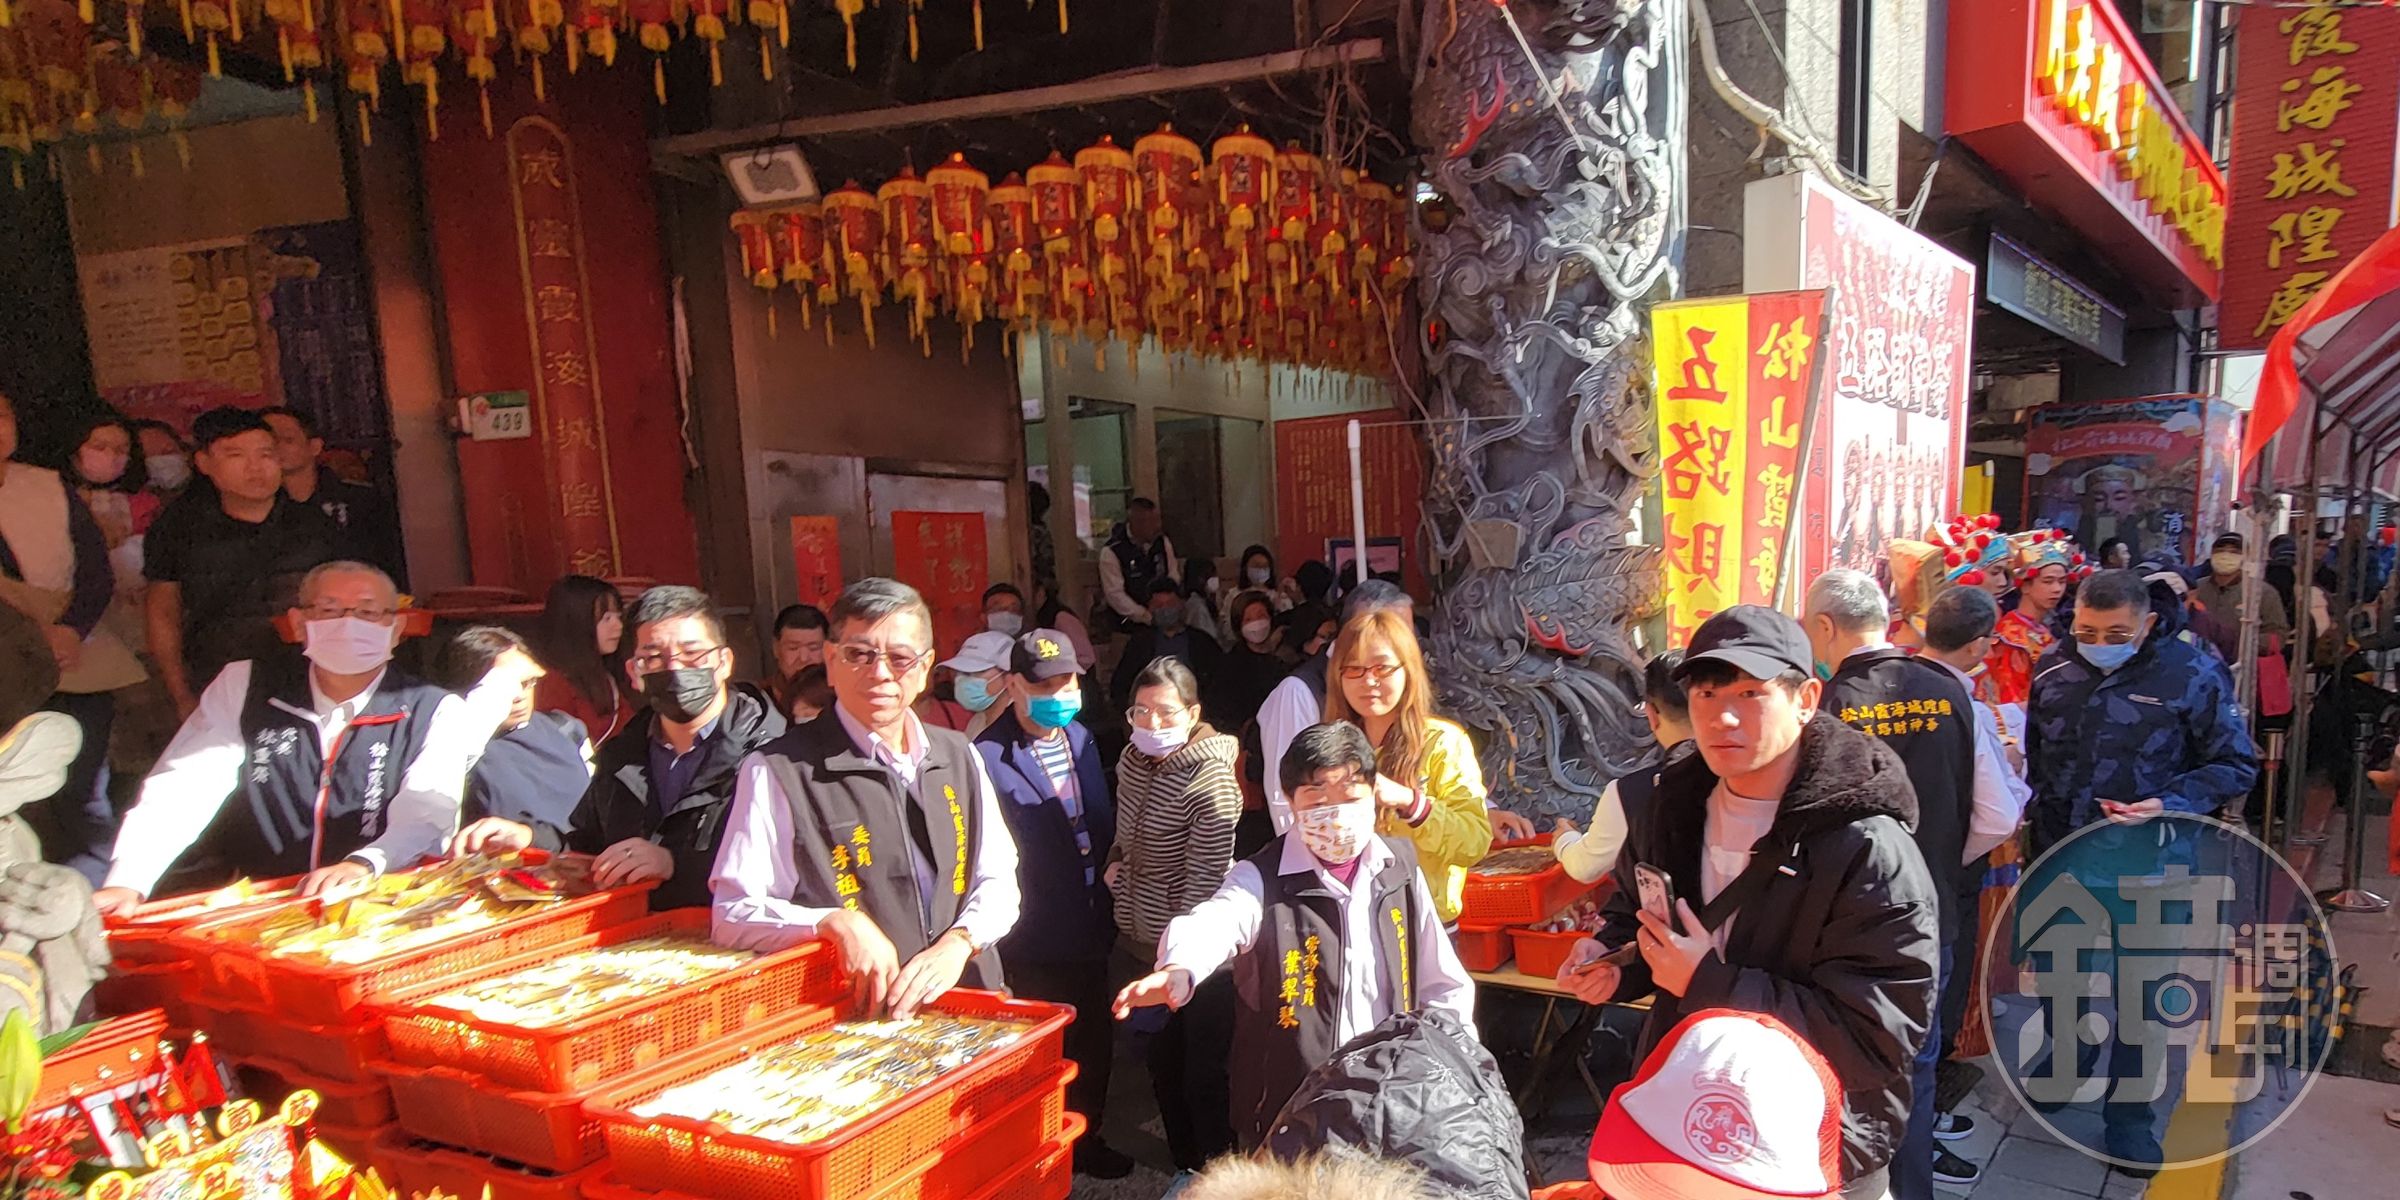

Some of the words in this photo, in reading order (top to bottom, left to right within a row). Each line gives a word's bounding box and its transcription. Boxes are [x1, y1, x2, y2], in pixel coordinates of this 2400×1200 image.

[491, 412, 523, 431] 439
[1036, 638, 1060, 658] LA
[1839, 699, 1952, 723] 松山霞海城隍廟
[850, 823, 873, 868] 委員
